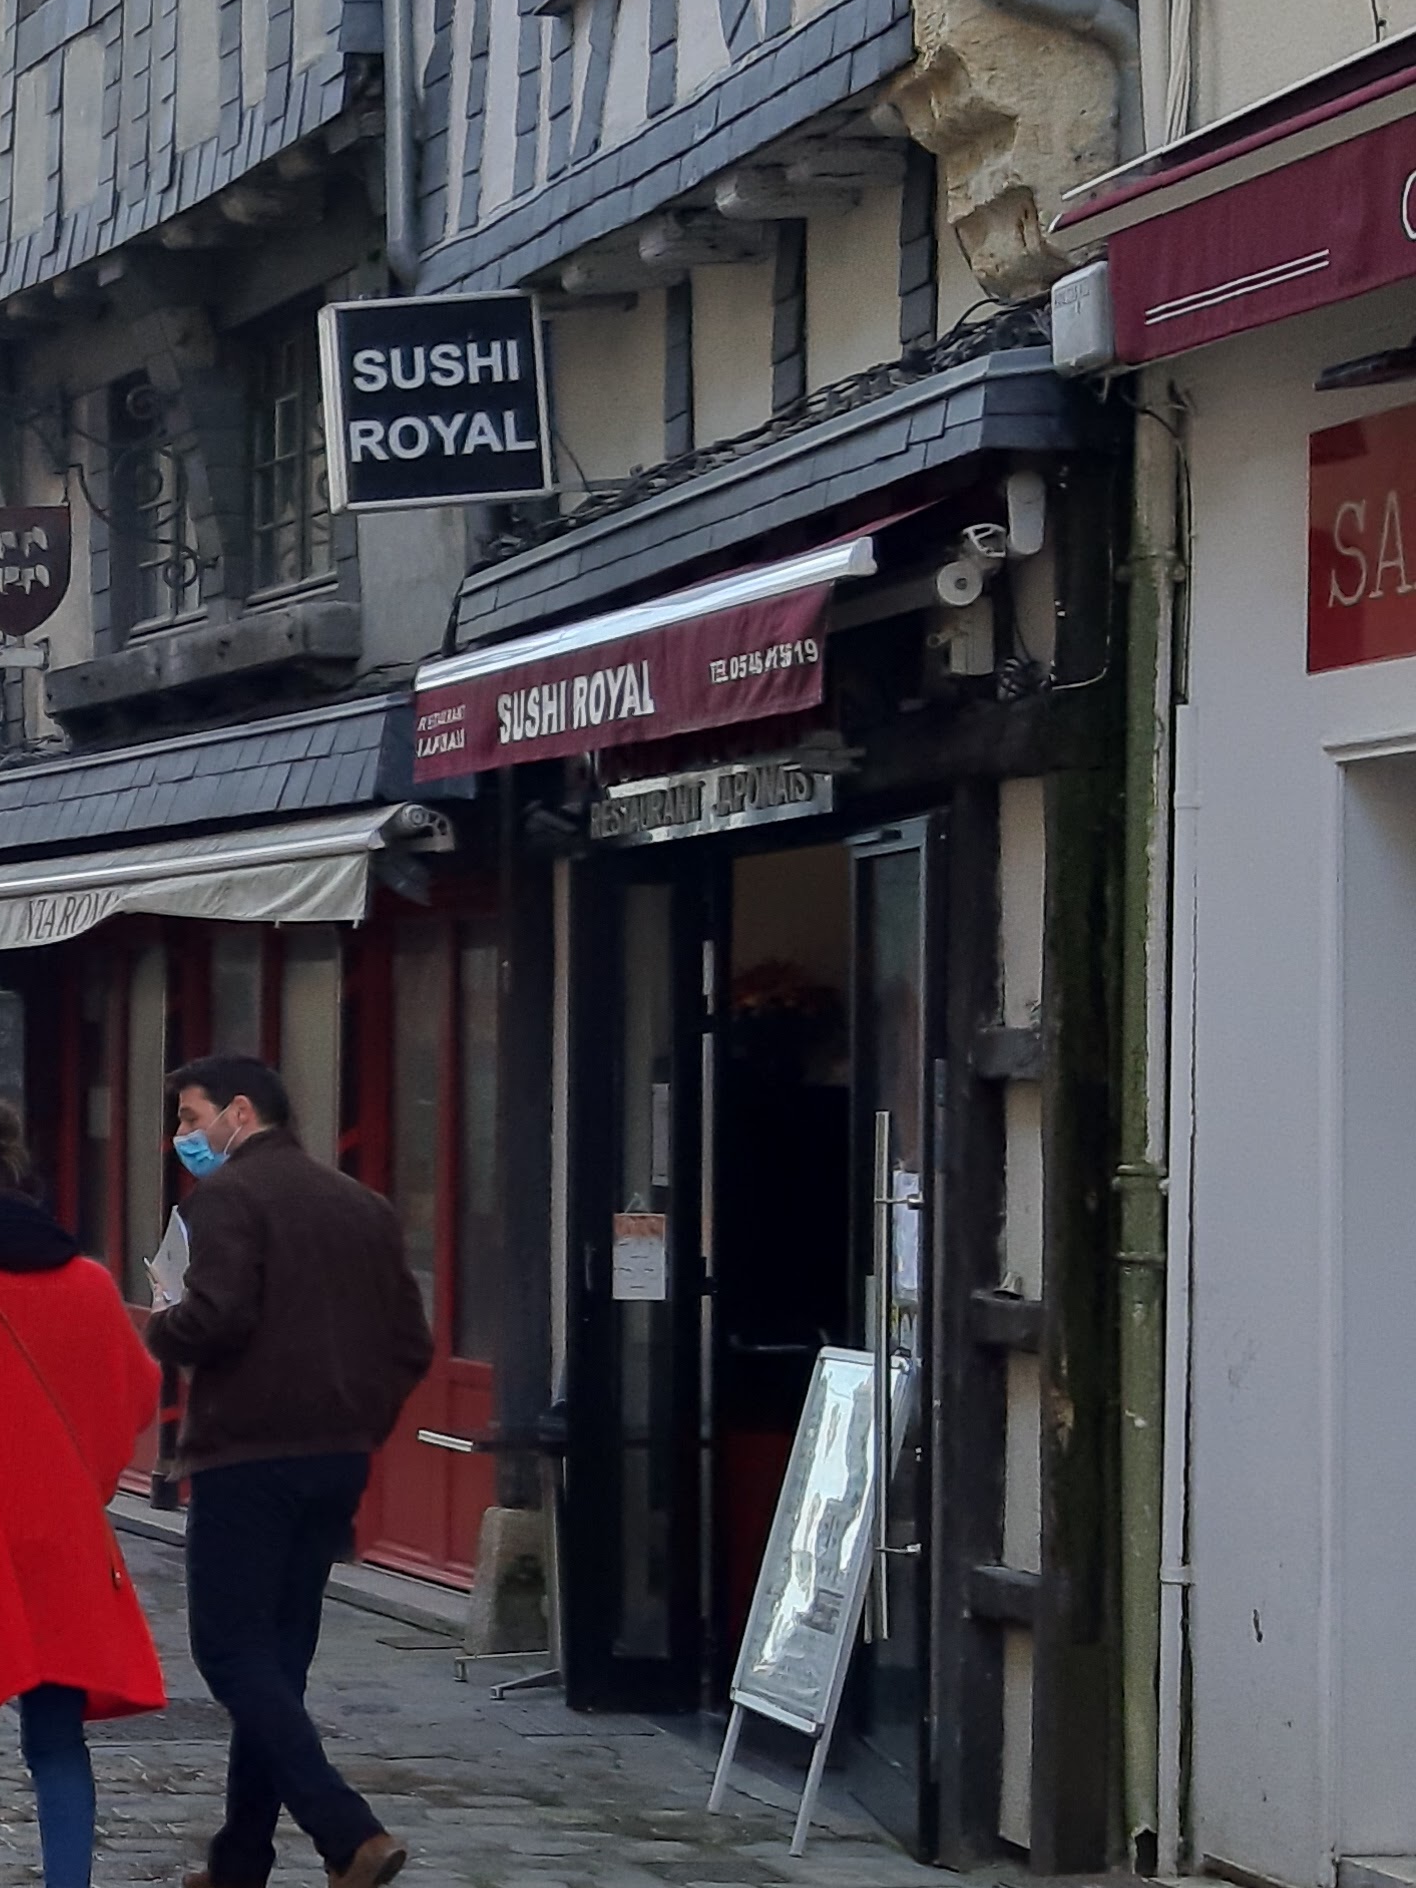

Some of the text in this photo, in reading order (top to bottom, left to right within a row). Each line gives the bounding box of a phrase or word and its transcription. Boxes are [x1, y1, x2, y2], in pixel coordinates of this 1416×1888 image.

[352, 338, 520, 393] SUSHI
[349, 409, 538, 463] ROYAL
[1328, 490, 1416, 608] SA
[497, 680, 567, 744] SUSHI
[573, 659, 655, 729] ROYAL
